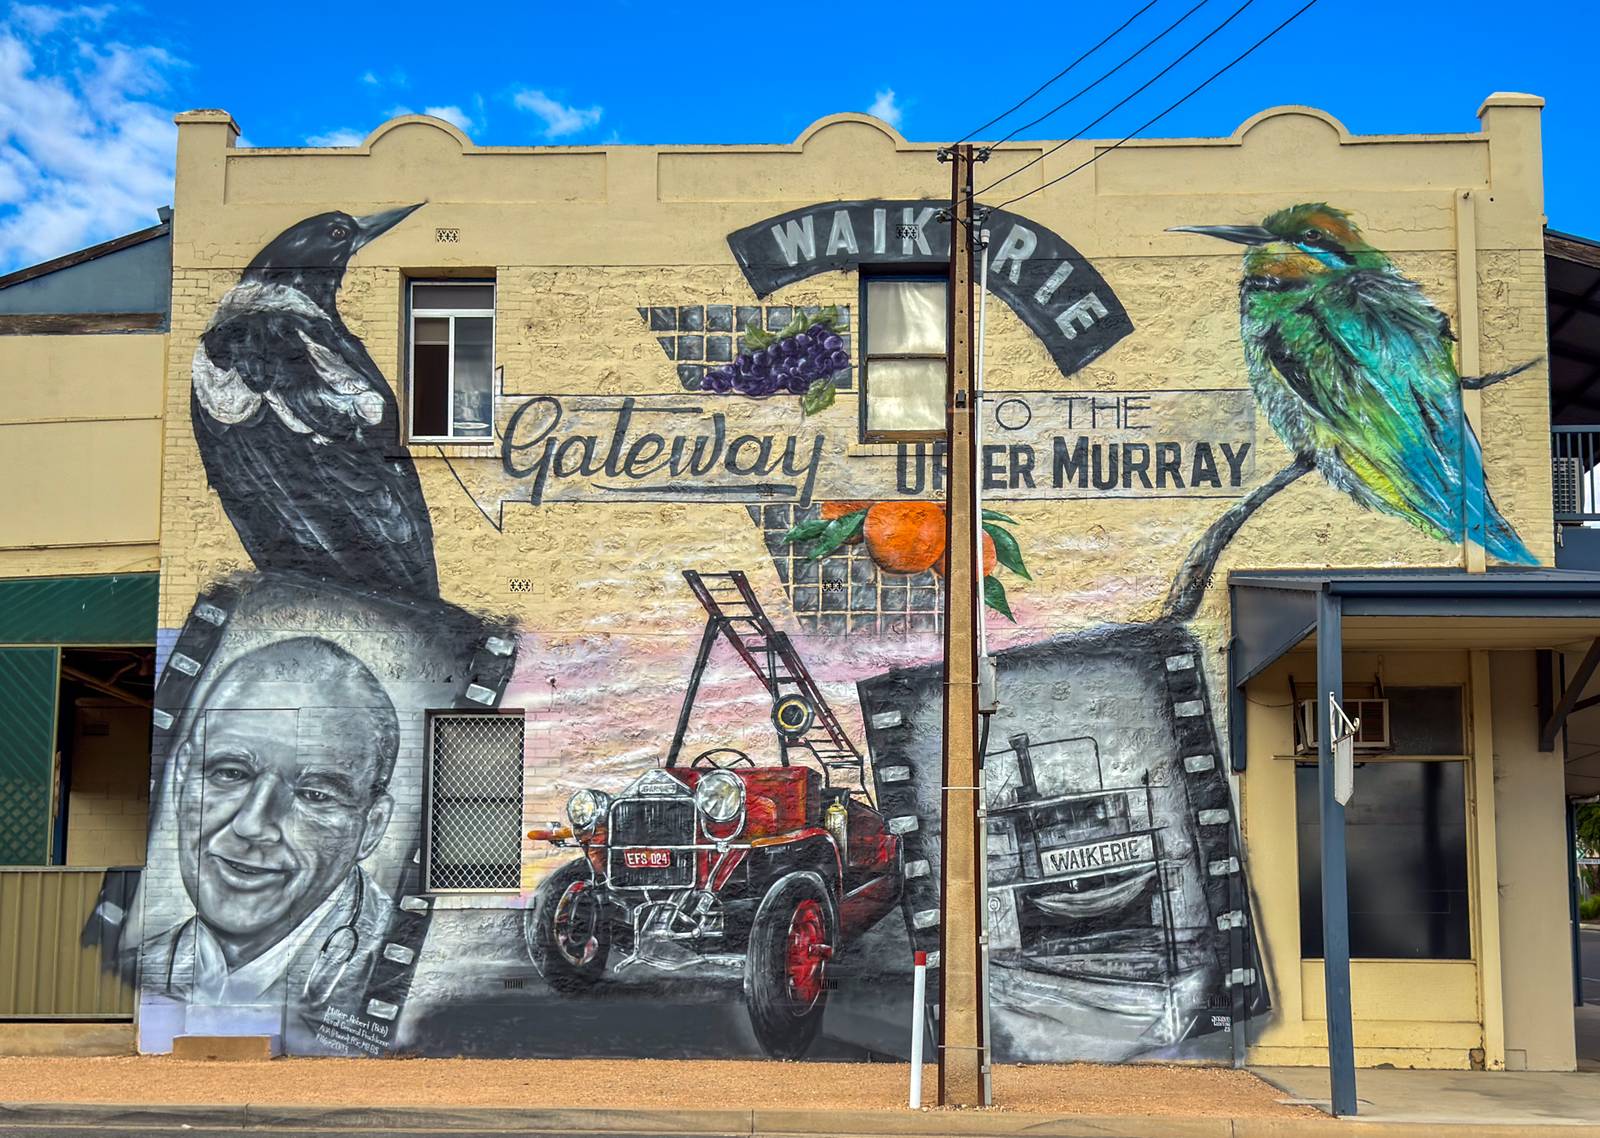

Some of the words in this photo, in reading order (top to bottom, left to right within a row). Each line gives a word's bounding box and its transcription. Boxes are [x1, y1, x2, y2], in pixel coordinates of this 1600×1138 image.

[771, 207, 1109, 340] WAIKRIE
[500, 396, 825, 508] Gateway
[981, 398, 1032, 431] O
[1052, 396, 1152, 431] THE
[897, 441, 1037, 495] UPER
[1052, 436, 1251, 491] MURRAY
[627, 853, 648, 865] EFS
[1050, 840, 1141, 871] WAIKERIE
